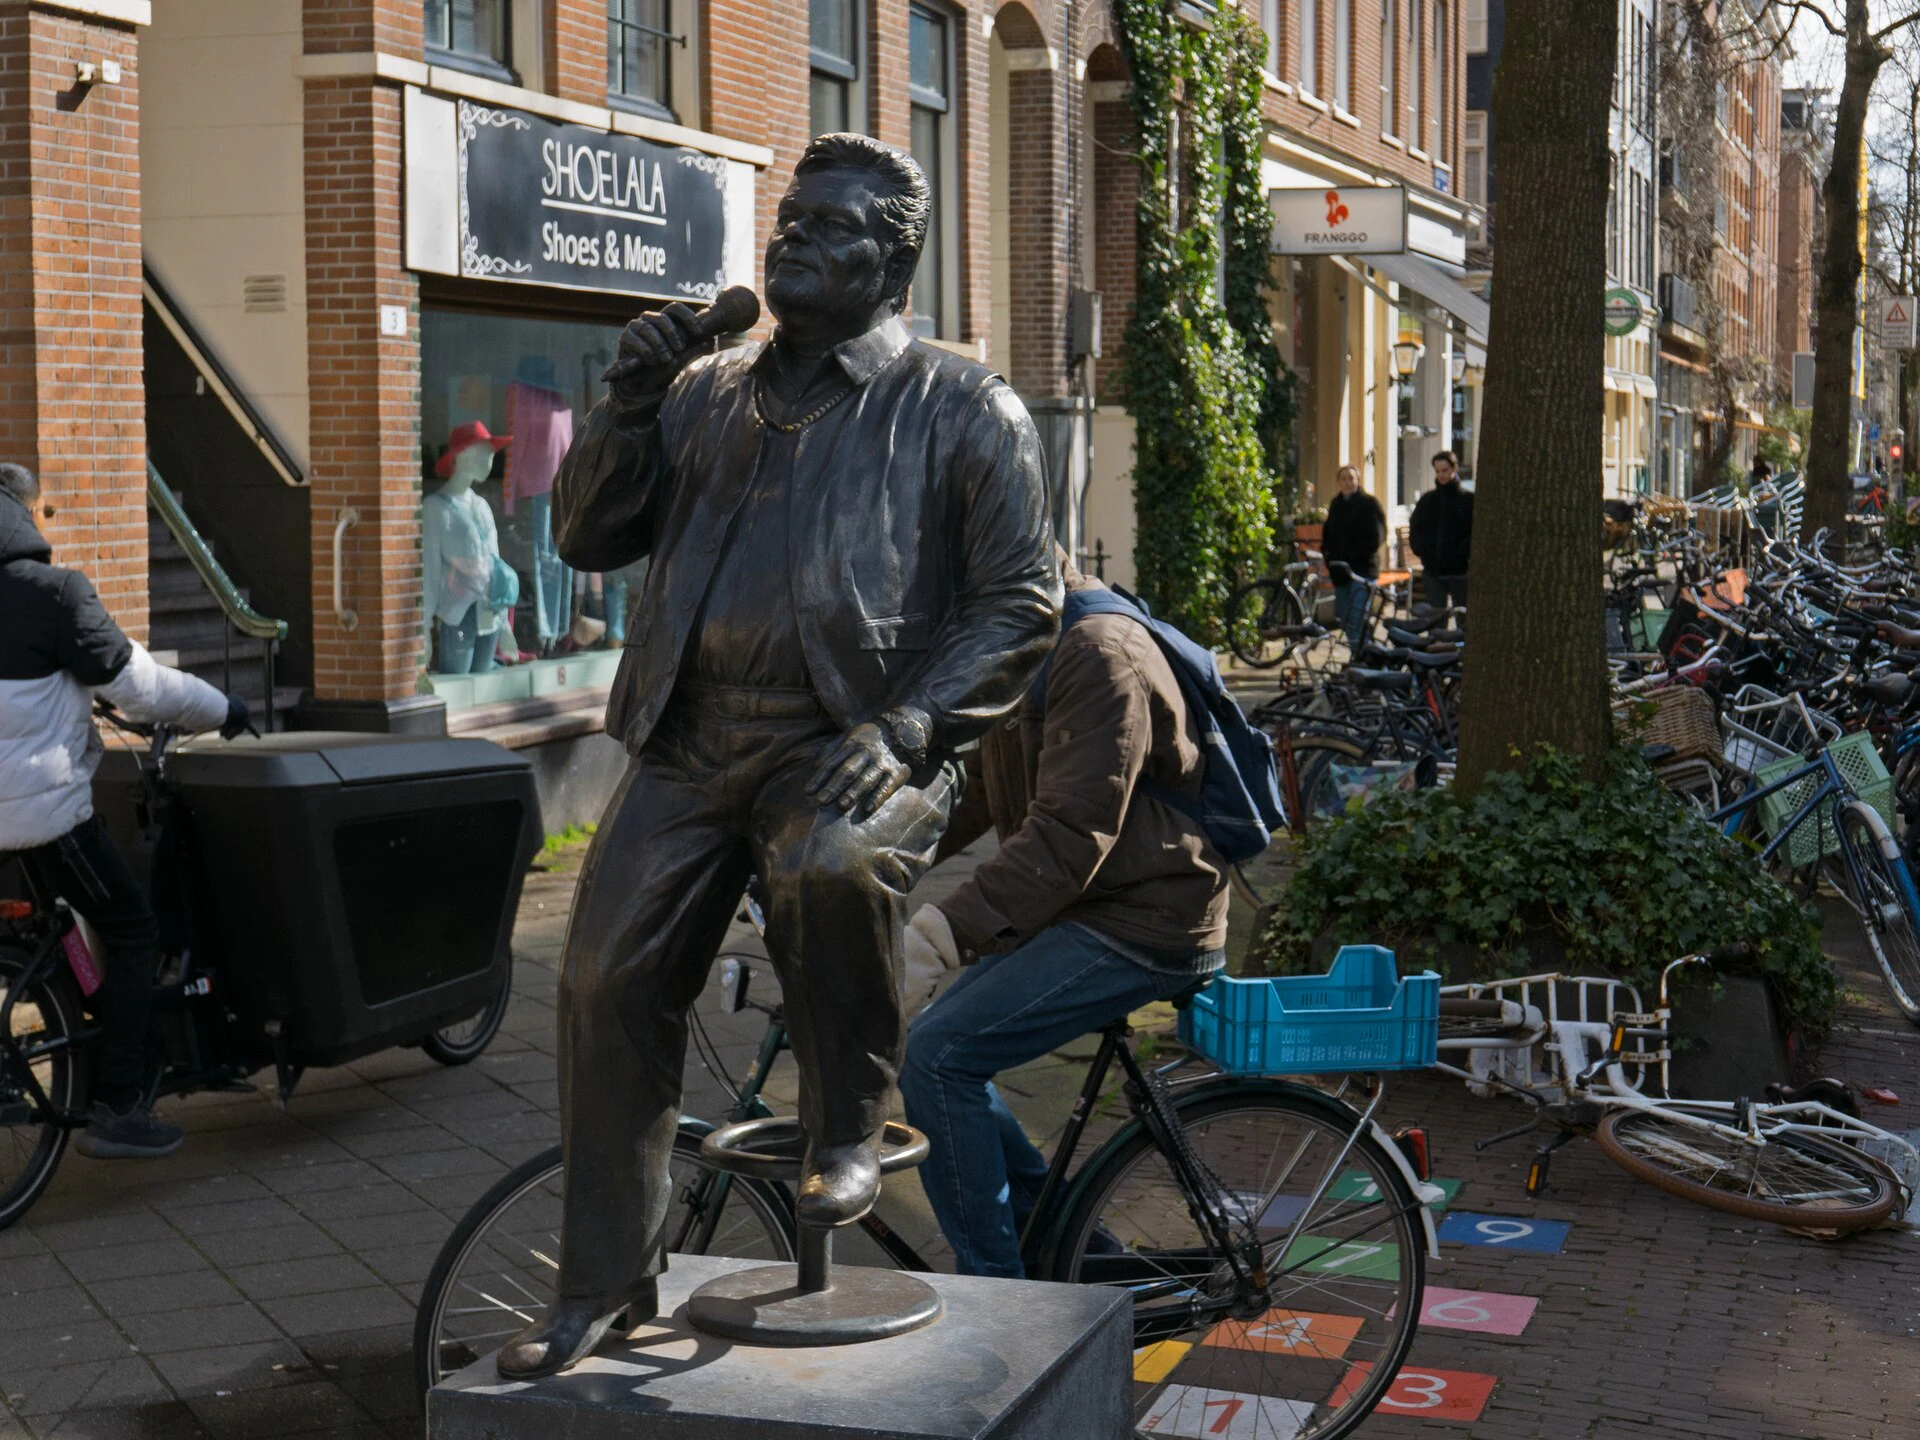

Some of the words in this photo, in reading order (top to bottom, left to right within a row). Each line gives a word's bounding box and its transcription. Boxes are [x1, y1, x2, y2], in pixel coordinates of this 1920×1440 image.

[541, 138, 666, 215] SHOELALA
[542, 220, 599, 266] Shoes
[603, 229, 620, 271] &
[624, 233, 666, 276] More
[1304, 231, 1368, 244] FRANGGO
[1475, 1219, 1535, 1244] 9
[1322, 1242, 1382, 1268] 7
[1427, 1296, 1491, 1323] 6
[1247, 1317, 1315, 1347] 4
[1381, 1373, 1448, 1408] 3
